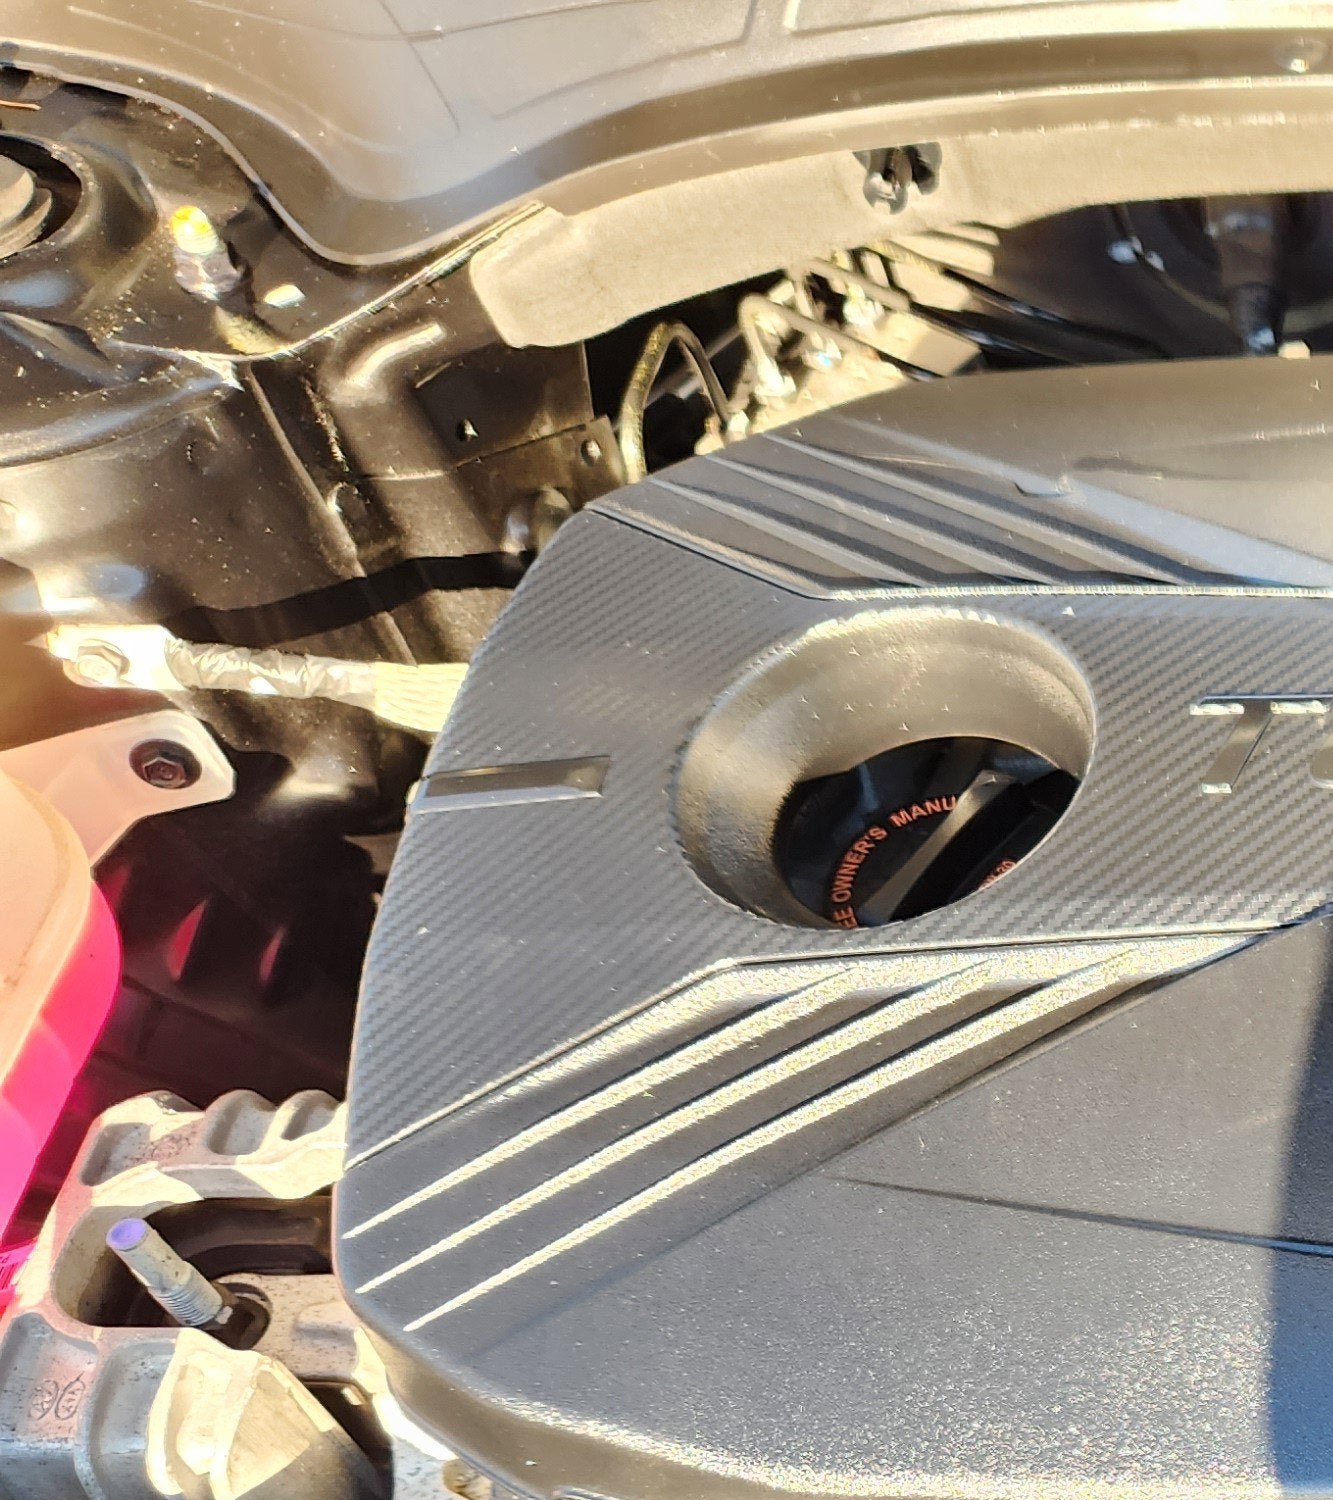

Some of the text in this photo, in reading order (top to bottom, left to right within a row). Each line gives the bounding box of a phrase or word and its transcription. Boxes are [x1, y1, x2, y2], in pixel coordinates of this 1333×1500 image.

[831, 794, 957, 929] EE OWNER'S MANU
